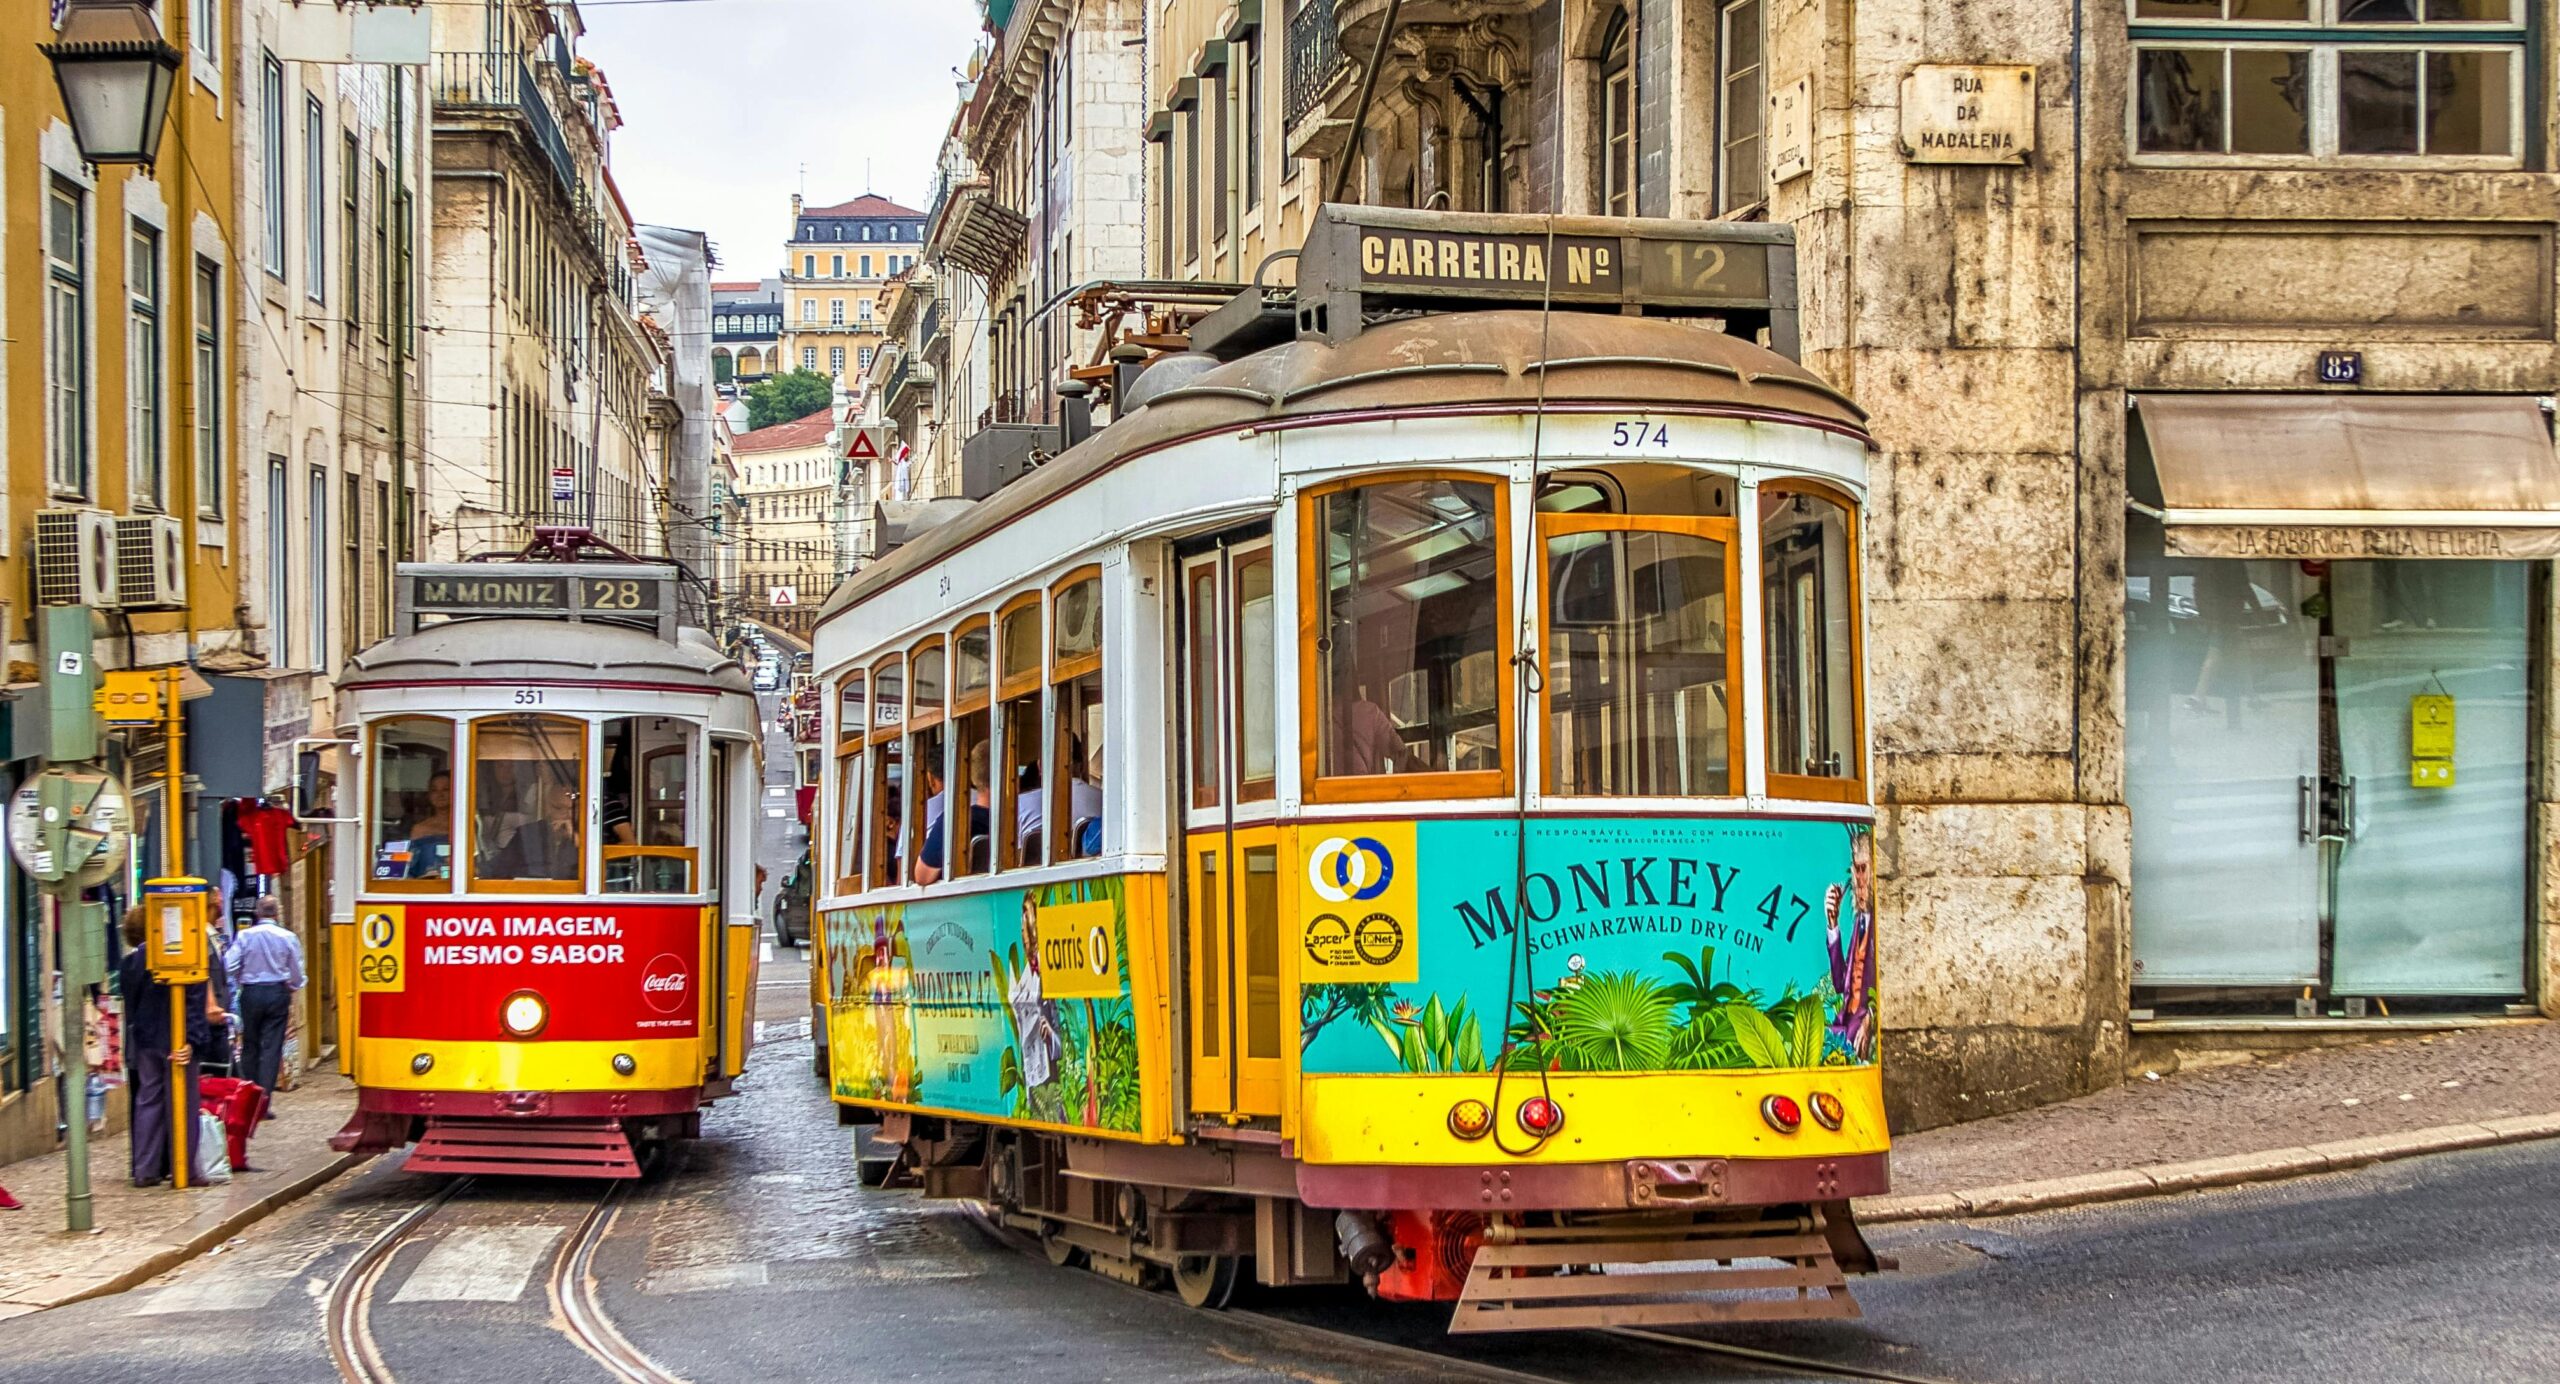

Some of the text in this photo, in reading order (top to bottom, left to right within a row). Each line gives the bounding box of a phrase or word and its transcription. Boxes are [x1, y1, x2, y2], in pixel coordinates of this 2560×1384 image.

[1953, 78, 1984, 93] RUA
[1957, 105, 1979, 121] DA
[1921, 132, 2013, 148] MADALENA
[1362, 235, 1610, 284] CARREIRA Nº
[1665, 242, 1727, 293] 12
[1613, 422, 1669, 447] 574
[2236, 530, 2259, 554] LA
[2266, 528, 2355, 554] FABBRICA
[594, 581, 641, 609] 28
[514, 690, 544, 704] 551
[1453, 857, 1811, 949] MONKEY 47
[425, 917, 624, 939] NOVA IMAGEM,
[1363, 935, 1393, 946] IQNet
[1529, 916, 1764, 954] SCHWARZWALD DRY GIN
[1045, 923, 1084, 970] carris
[1313, 935, 1344, 947] apcer
[424, 944, 625, 965] MESMO SABOR
[915, 970, 993, 1019] MONKEY 47
